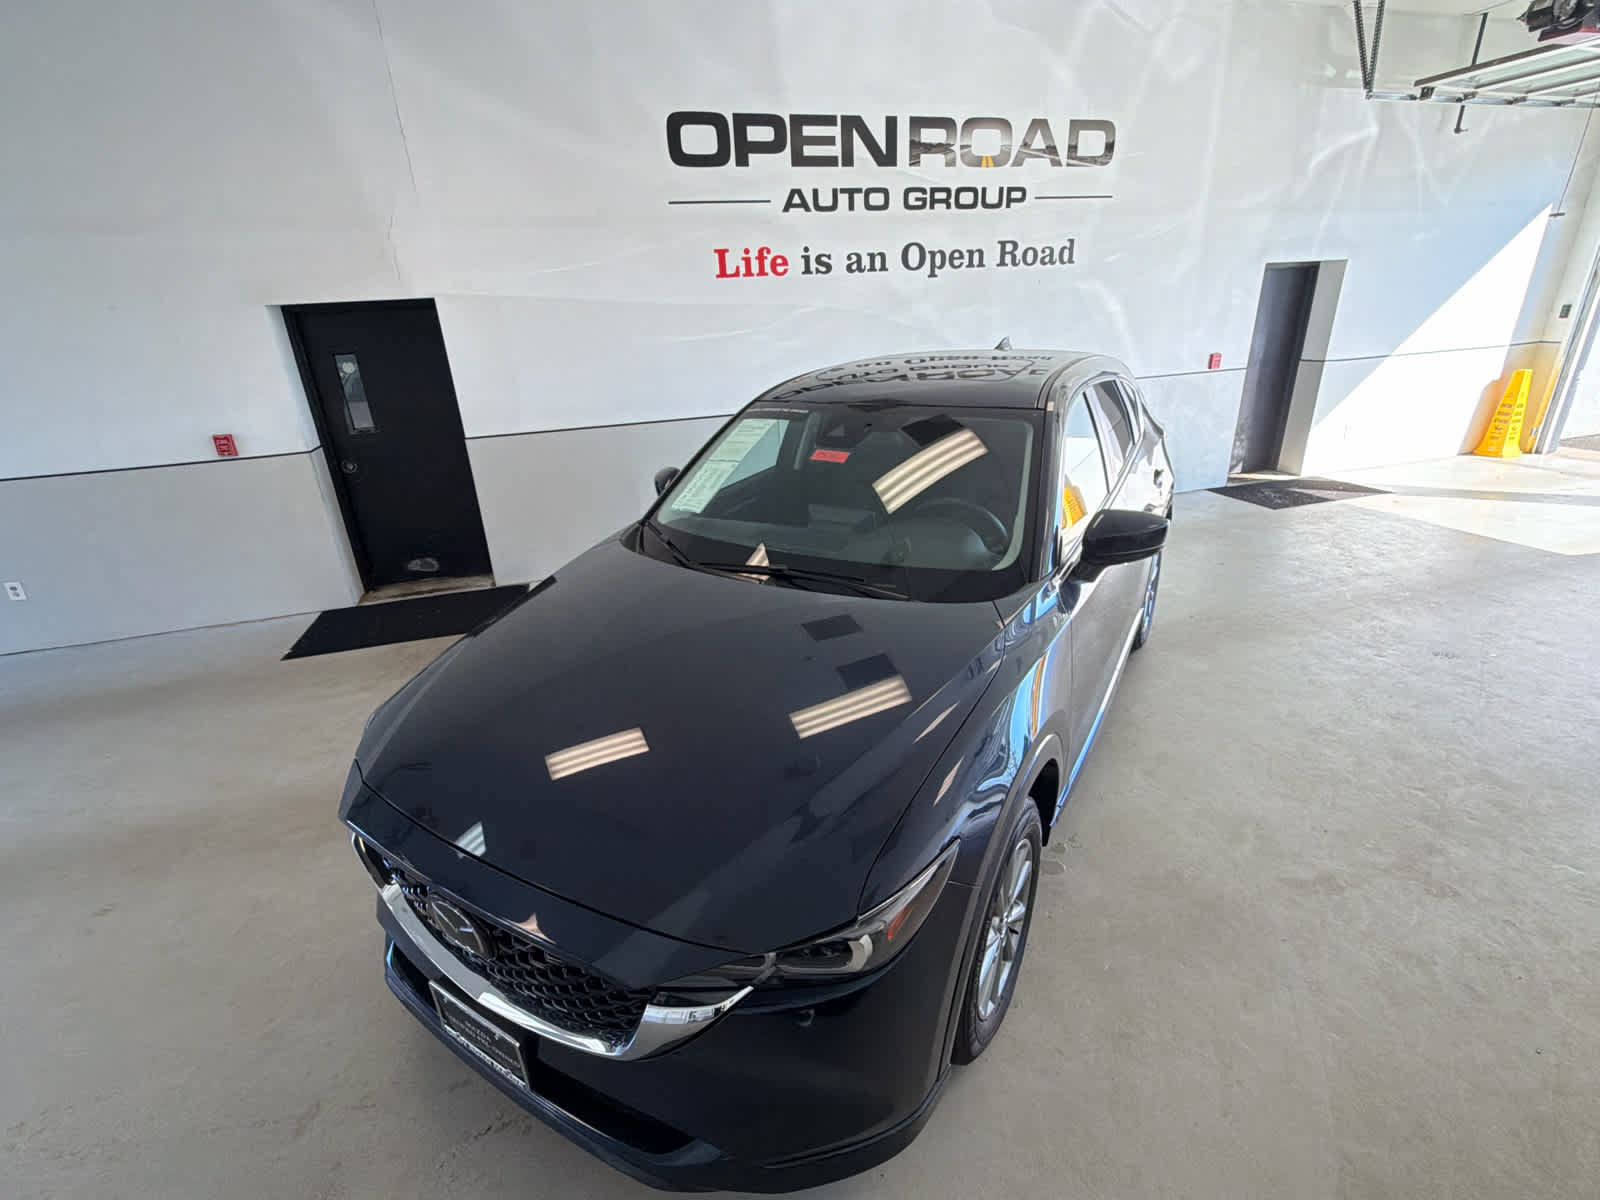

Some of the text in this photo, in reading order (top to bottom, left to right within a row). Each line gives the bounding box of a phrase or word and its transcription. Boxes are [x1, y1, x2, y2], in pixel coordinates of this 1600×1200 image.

[783, 186, 1027, 213] AUTO GROUP
[713, 238, 1076, 279] Life is an Open Road
